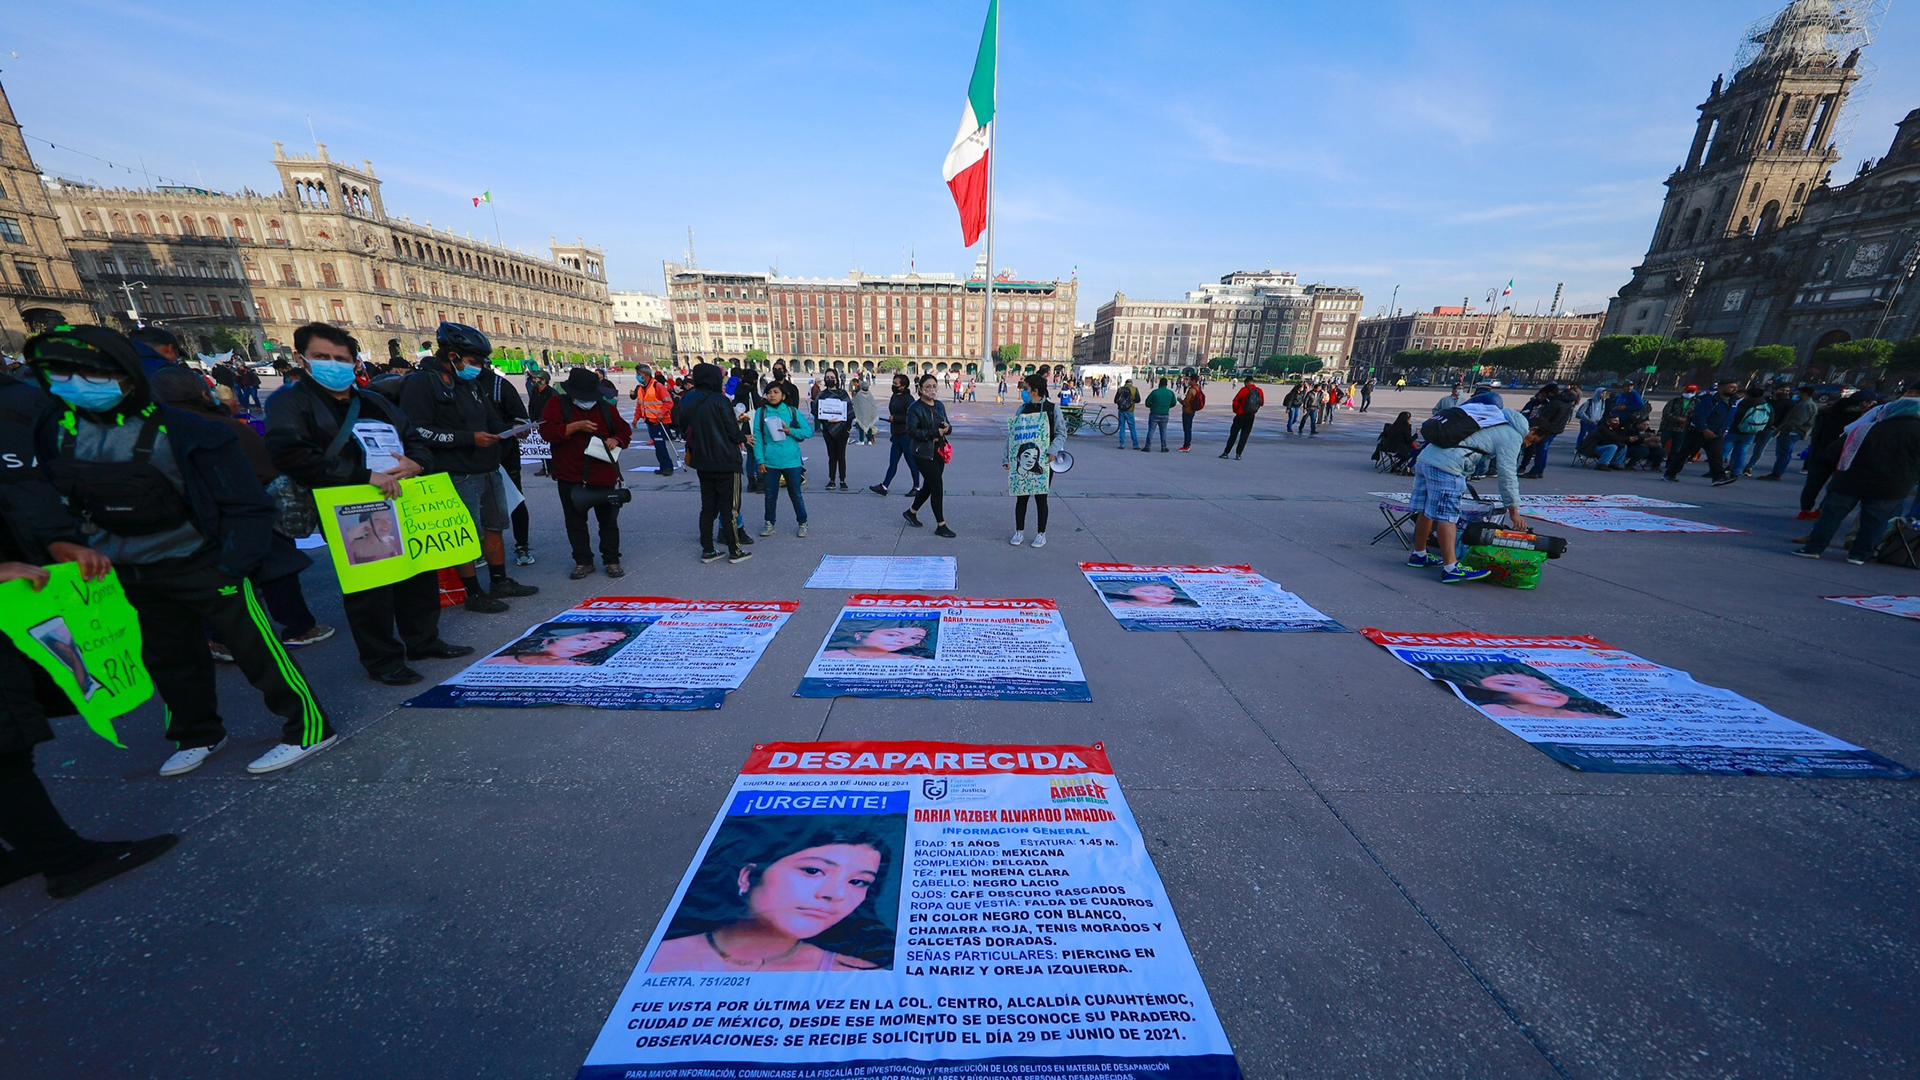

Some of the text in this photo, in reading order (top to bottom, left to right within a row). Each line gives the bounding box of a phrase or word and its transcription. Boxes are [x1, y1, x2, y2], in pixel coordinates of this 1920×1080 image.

[407, 526, 474, 560] DARIA
[588, 601, 781, 611] DESAPARECIDA
[860, 598, 1044, 609] DESAPARECIDA
[1381, 632, 1598, 649] DESAPARECIDA
[768, 752, 1088, 770] DESAPARECIDA
[1050, 776, 1090, 787] ALERTA
[1051, 785, 1106, 799] AMBER
[744, 796, 887, 813] ¡URGENTE!
[914, 809, 951, 822] DARIA
[954, 809, 998, 822] YAZBEK
[1001, 808, 1062, 822] ALVARADO
[950, 839, 965, 848] 15
[914, 849, 998, 857] NACIONALIDAD:
[914, 858, 988, 867] COMPLEXIÓN:
[913, 869, 936, 877] TEZ:
[912, 879, 969, 888] CABELLO:
[973, 879, 1017, 887] NEGRO
[911, 890, 946, 899] OJOS:
[1055, 886, 1126, 896] RASGADOS
[910, 902, 943, 910] ROPA
[946, 902, 971, 910] QUE
[974, 899, 1020, 909] VESTÍA:
[1091, 897, 1154, 907] CUADROS
[910, 910, 1126, 922] EN COLOR NEGRO CON BLANCO,
[909, 923, 1161, 935] CHAMARRA ROJA, TENIS MORADOS Y
[908, 936, 1057, 947] CALCETAS DORADAS.
[907, 948, 1155, 961] SEÑAS PARTICULARES: PIERCING EN
[906, 964, 1132, 976] LA NARIZ Y OREJA IZQUIERDA.
[642, 977, 750, 987] ALERTA. 751/2021
[631, 993, 1194, 1012] FUE VISTA POR ÚLTIMA VEZ EN LA COL. CENTRO, ALCALDÍA CUAUHTÉMOC,
[628, 1011, 1196, 1030] CIUDAD DE MÉXICO, DESDE ESE MOMENTO SE DESCONOCE SU PARADERO.
[636, 1028, 1186, 1048] OBSERVACIONES: SE RECIBE SOLICITUD EL DÍA 29 DE JUNIO DE 2021.
[648, 1070, 678, 1078] MAYOR
[678, 1068, 736, 1078] INFORMACIÓN,
[738, 1070, 797, 1078] COMUNICARSE
[817, 1067, 852, 1078] FISCALÍA
[854, 1067, 865, 1076] DE
[867, 1065, 926, 1075] INVESTIGACIÓN
[934, 1063, 988, 1074] PERSECUCIÓN
[990, 1064, 1001, 1072] DE
[1003, 1064, 1018, 1073] LOS
[1020, 1064, 1052, 1072] DELITOS
[1113, 1062, 1170, 1071] DESAPARICIÓN
